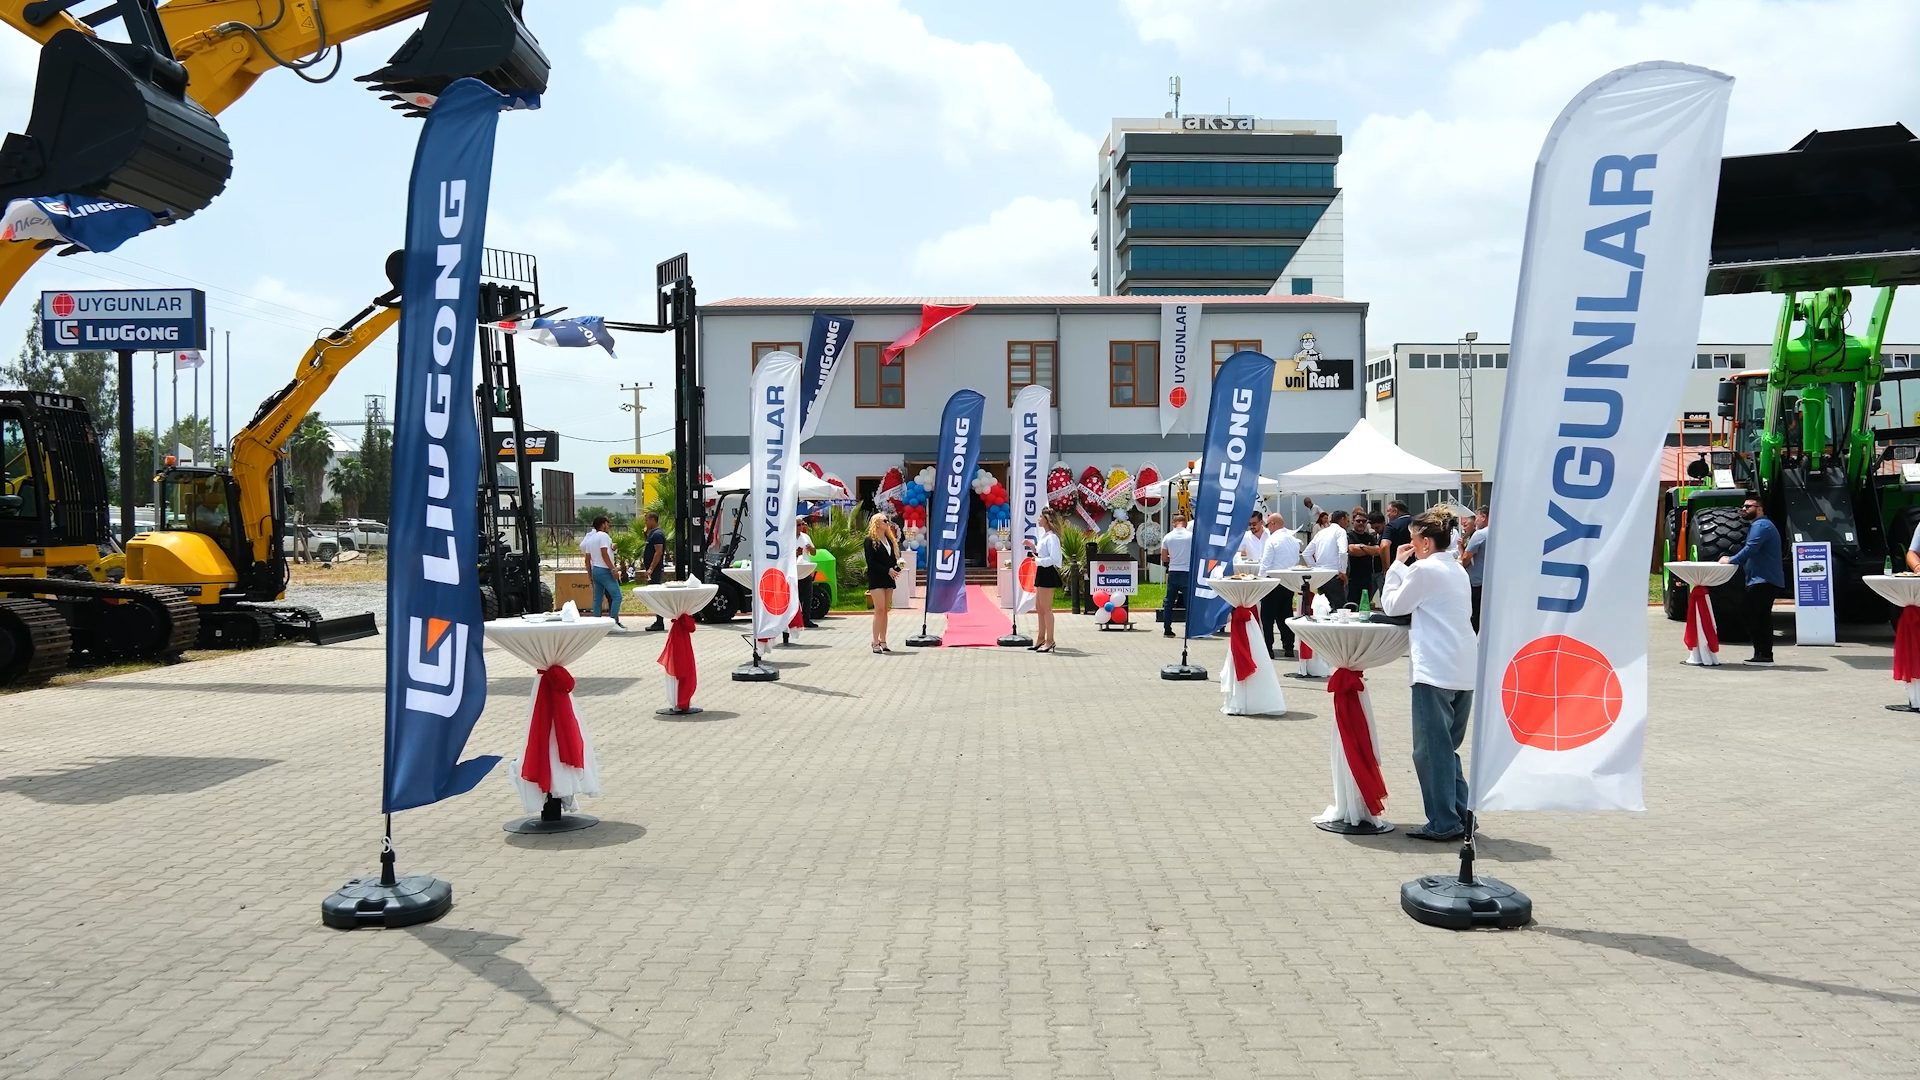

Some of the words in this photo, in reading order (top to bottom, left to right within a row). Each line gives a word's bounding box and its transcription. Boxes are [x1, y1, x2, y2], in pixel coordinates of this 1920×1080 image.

[1184, 115, 1253, 130] aksa
[78, 297, 182, 312] UYGUNLAR
[1174, 305, 1187, 384] UYGUNLAR
[1537, 153, 1658, 614] UYGUNLAR
[501, 437, 547, 448] CSE
[766, 385, 785, 560] UYGUNLAR
